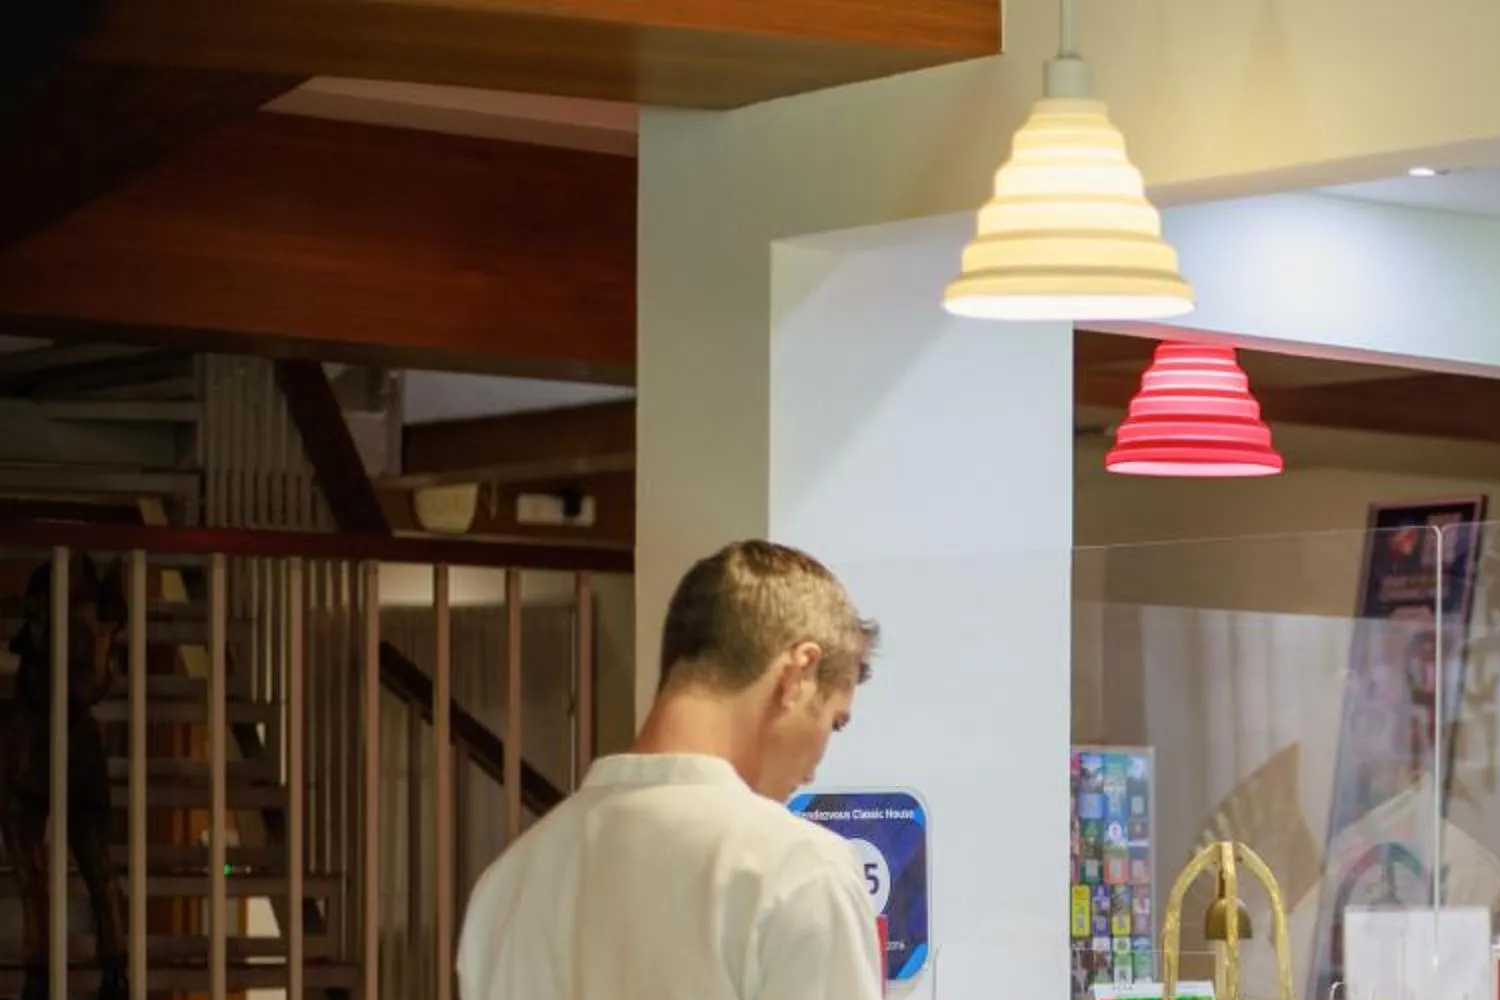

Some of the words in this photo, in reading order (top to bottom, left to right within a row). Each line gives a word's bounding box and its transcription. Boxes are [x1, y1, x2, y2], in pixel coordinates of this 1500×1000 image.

[852, 808, 884, 819] Classic
[885, 808, 915, 819] House
[863, 863, 879, 895] 5
